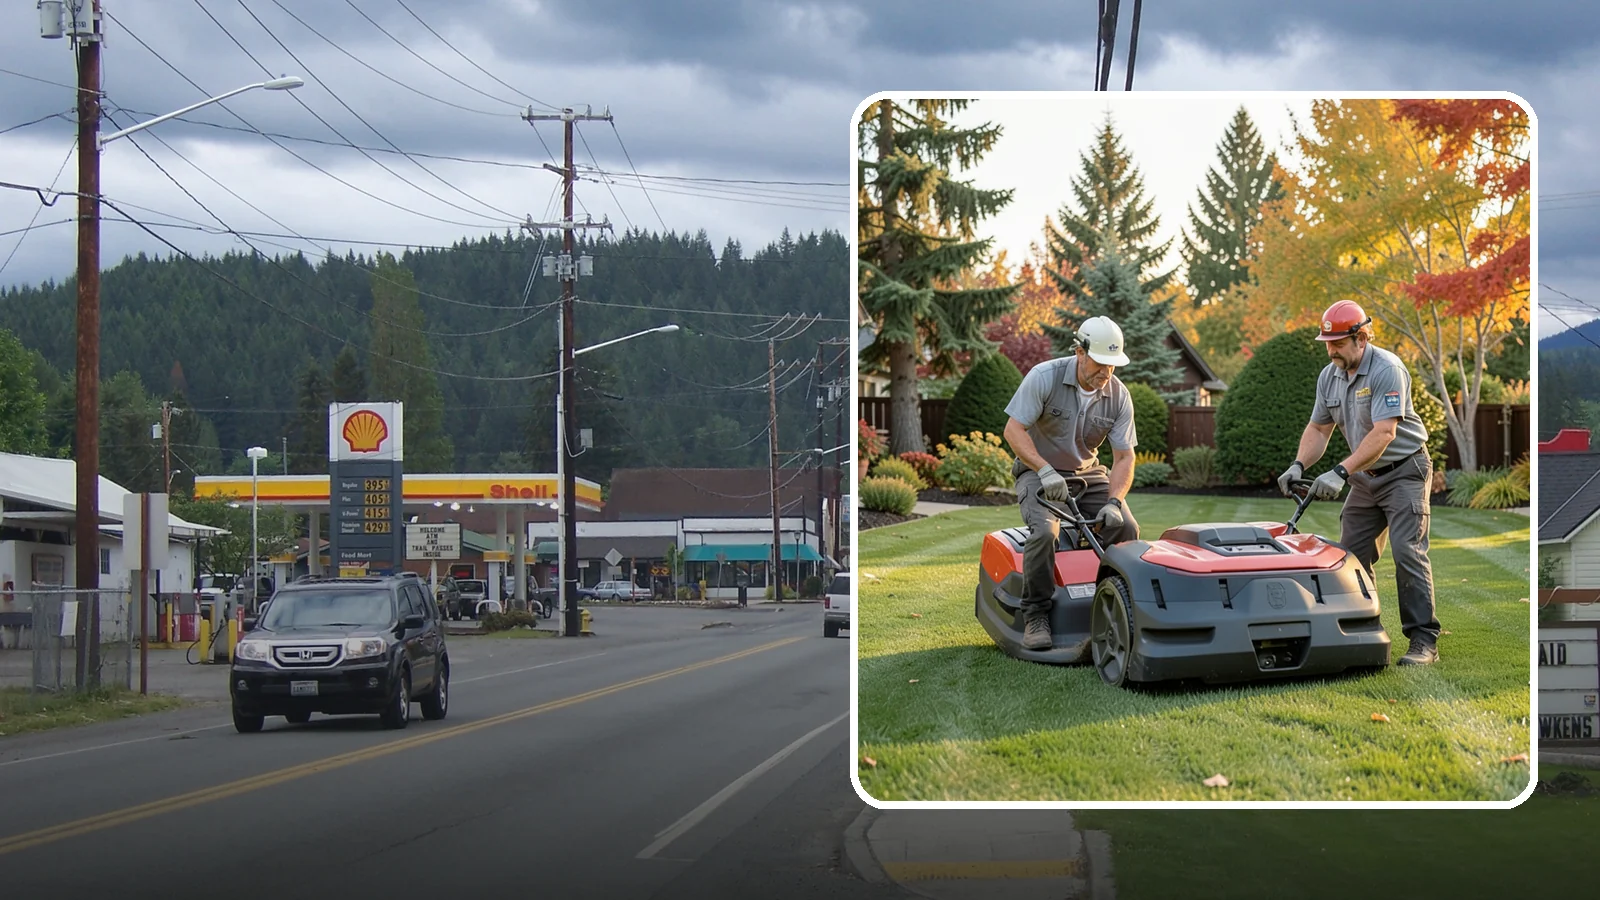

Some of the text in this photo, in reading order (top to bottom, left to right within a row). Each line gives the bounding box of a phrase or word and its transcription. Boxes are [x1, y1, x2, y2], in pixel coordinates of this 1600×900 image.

[365, 480, 383, 490] 395
[490, 484, 547, 499] Shell
[365, 494, 383, 504] 405
[365, 508, 383, 518] 415
[365, 522, 383, 532] 429
